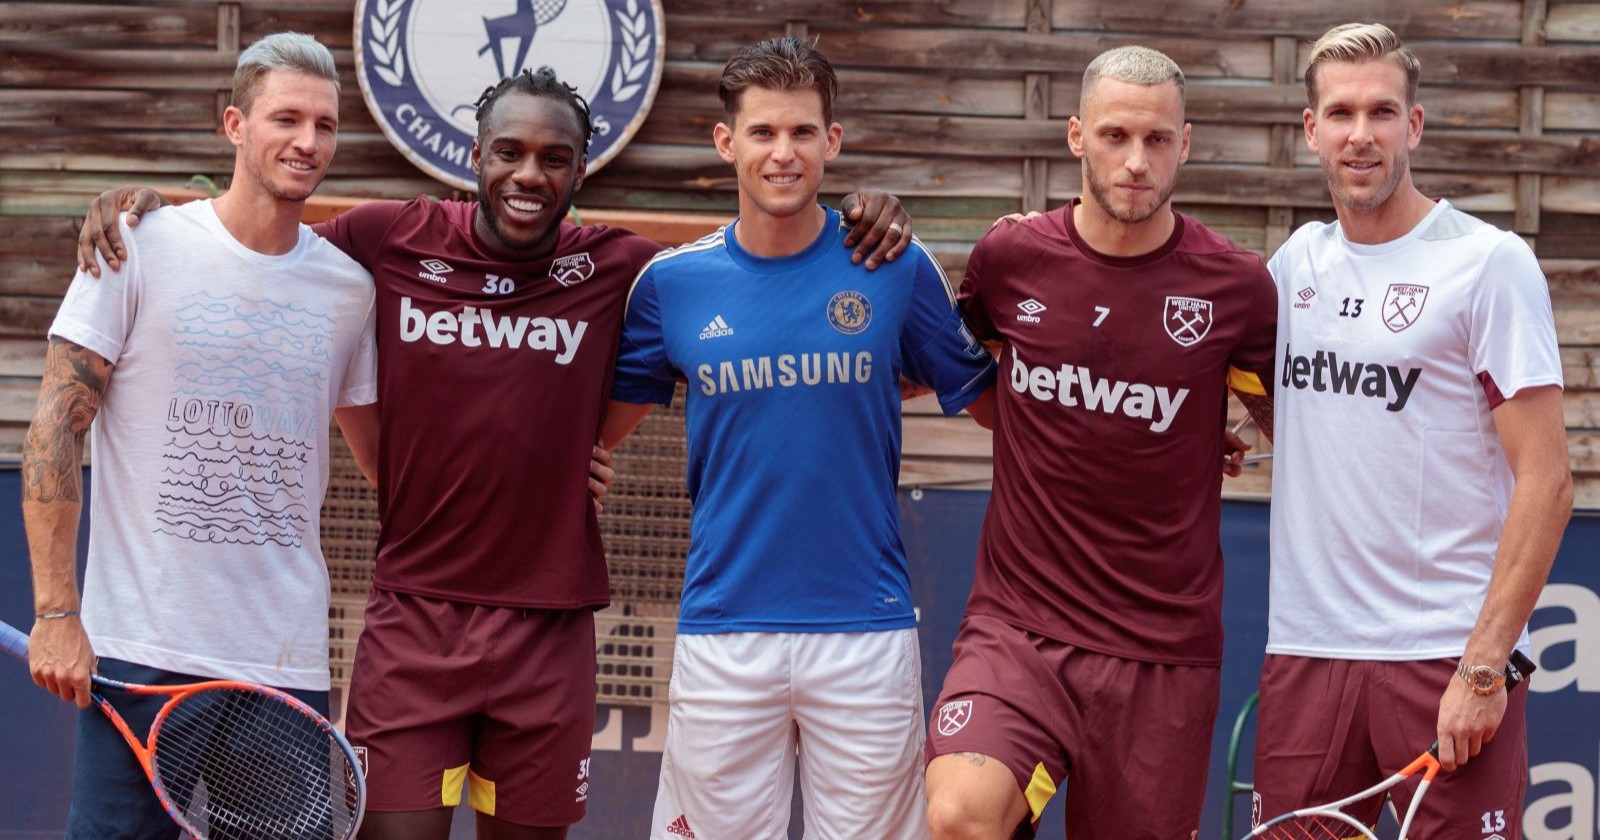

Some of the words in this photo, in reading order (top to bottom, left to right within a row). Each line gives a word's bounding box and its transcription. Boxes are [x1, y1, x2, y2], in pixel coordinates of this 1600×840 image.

[419, 271, 447, 283] umbro
[482, 273, 505, 294] 30
[1092, 305, 1110, 327] 7
[1339, 297, 1364, 318] 13
[1016, 314, 1040, 323] umbro
[400, 297, 589, 365] betway
[699, 327, 734, 340] adidas
[697, 351, 873, 396] SAMSUNG
[1281, 343, 1422, 412] betway
[1011, 345, 1190, 433] betway
[667, 825, 696, 839] adidas
[1481, 810, 1506, 834] 13
